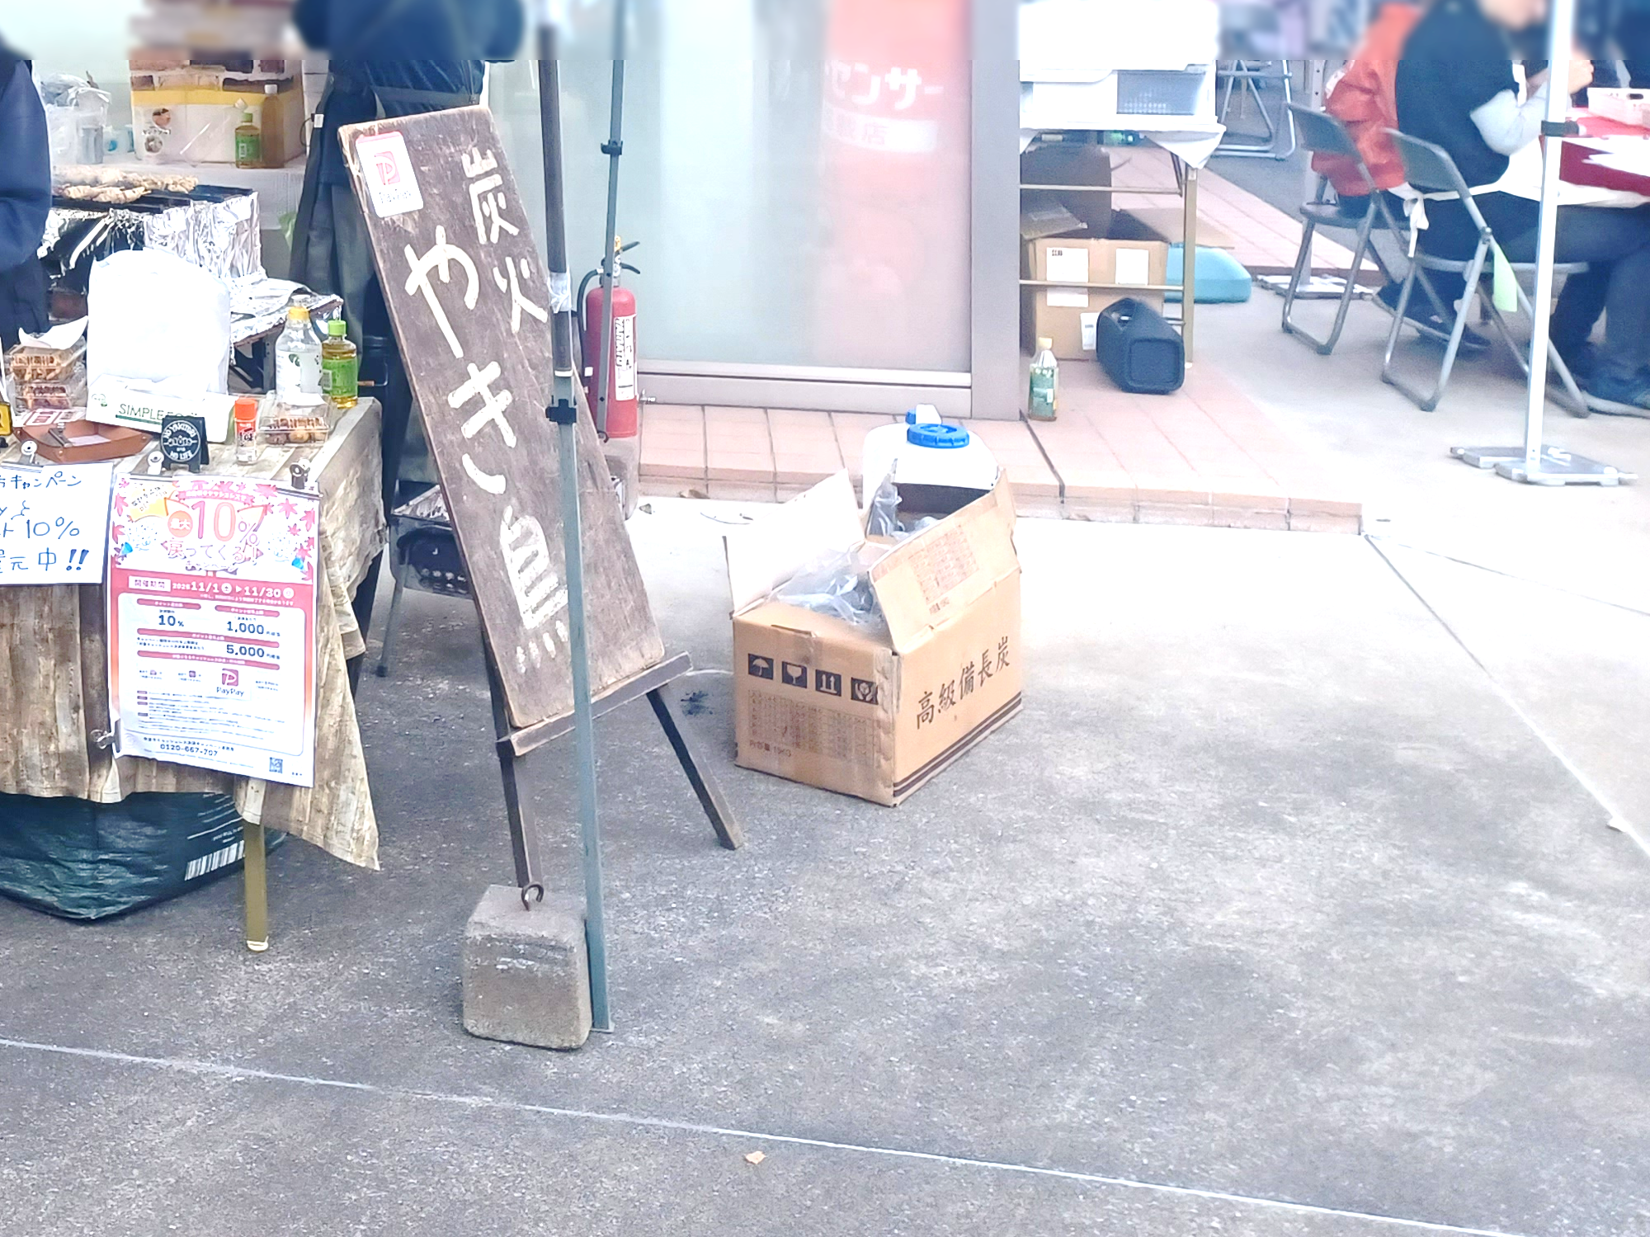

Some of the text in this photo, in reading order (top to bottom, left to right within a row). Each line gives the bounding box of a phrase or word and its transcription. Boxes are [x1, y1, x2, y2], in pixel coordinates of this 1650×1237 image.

[461, 146, 548, 335] 炭火
[118, 403, 164, 421] SIMPLE
[404, 225, 570, 674] やき鳥
[26, 516, 81, 540] 10%
[190, 581, 221, 593] 11/1
[243, 585, 282, 598] 11/30
[916, 635, 1010, 730] 高級備長炭
